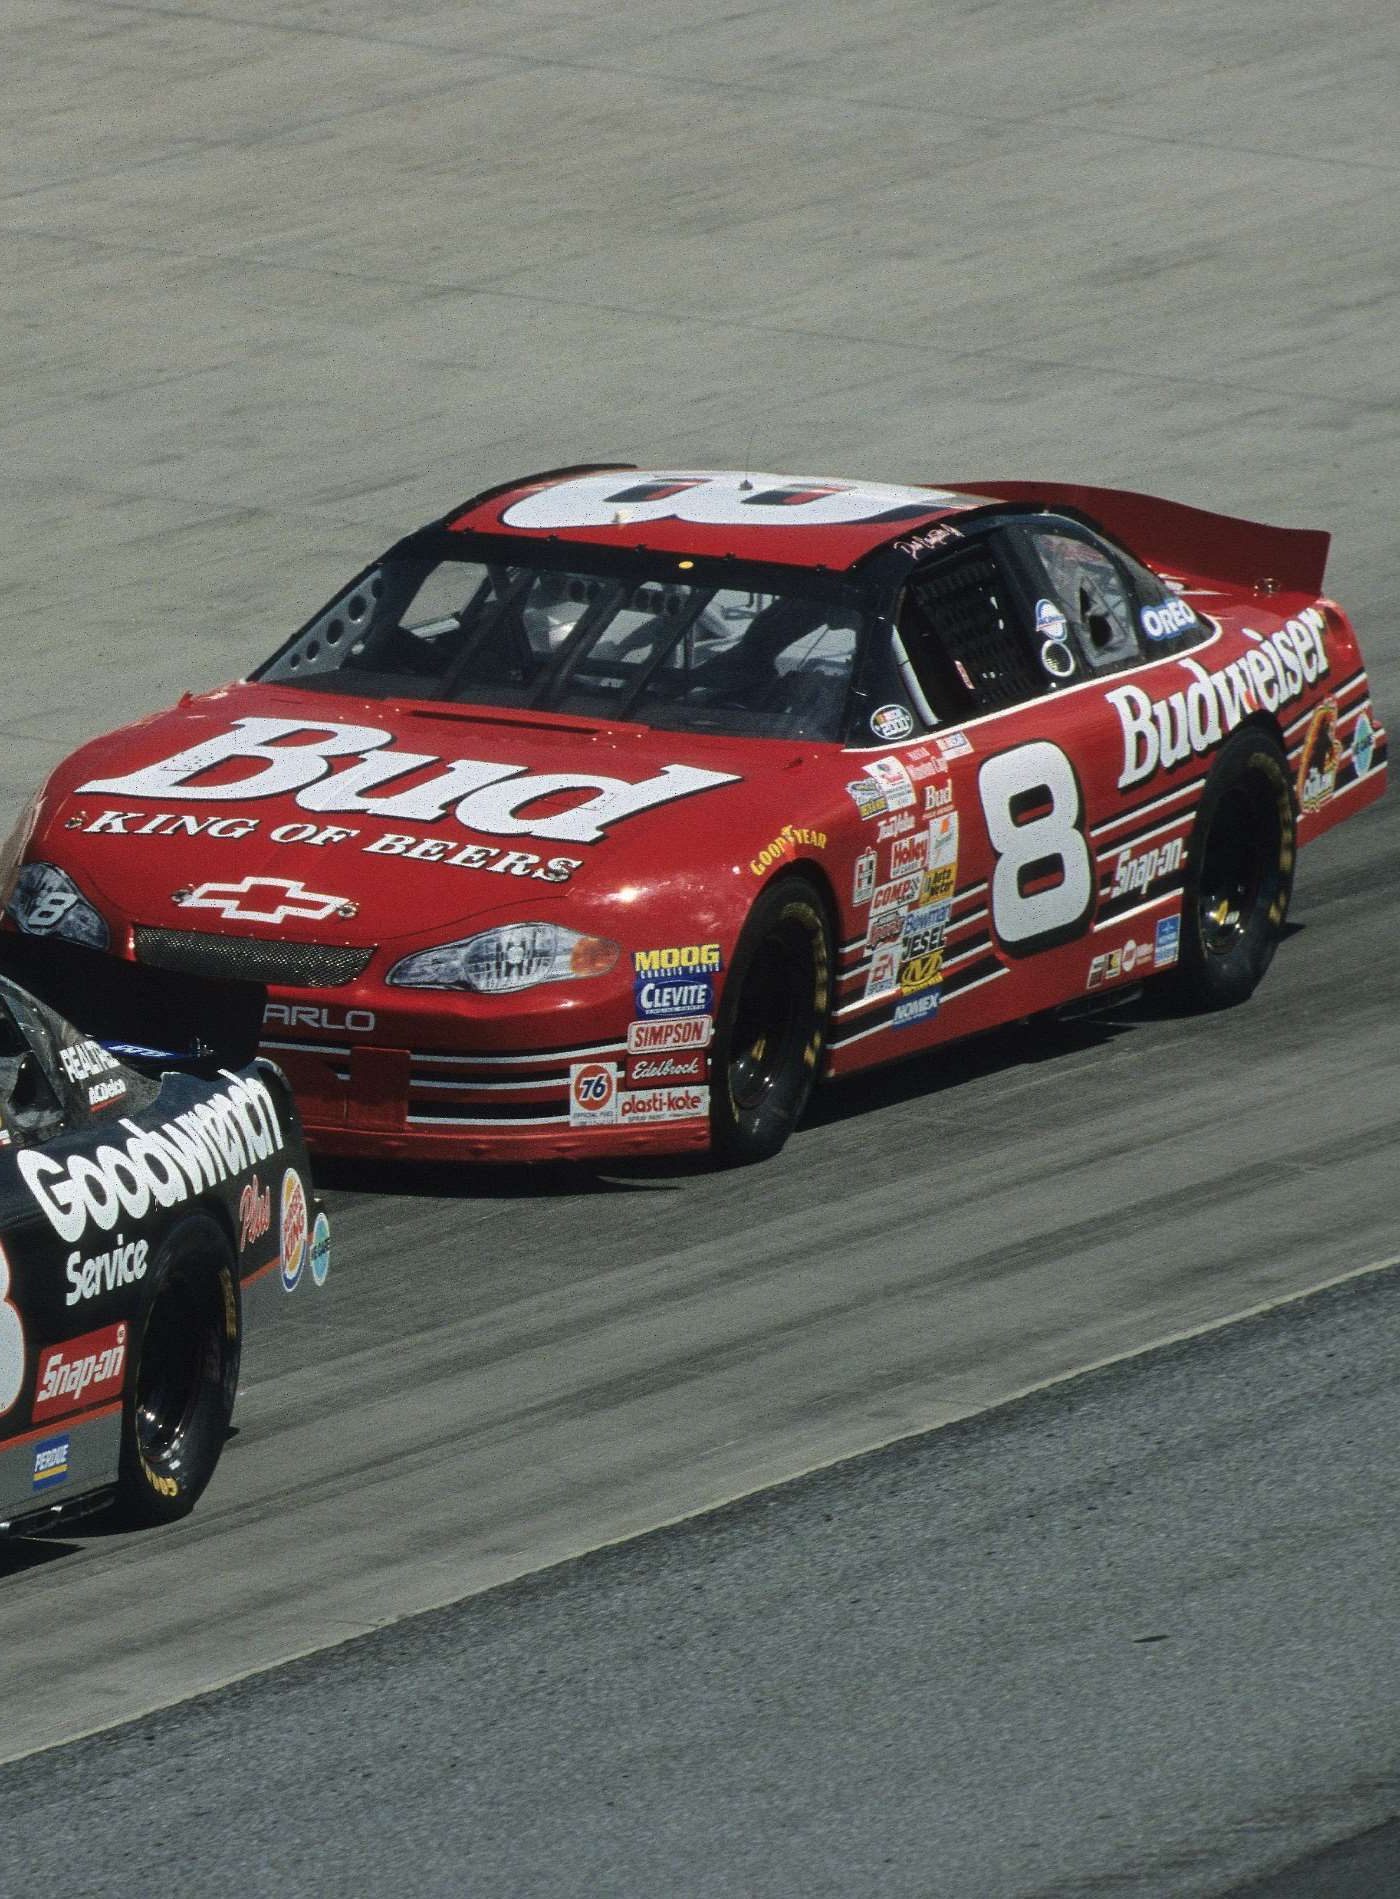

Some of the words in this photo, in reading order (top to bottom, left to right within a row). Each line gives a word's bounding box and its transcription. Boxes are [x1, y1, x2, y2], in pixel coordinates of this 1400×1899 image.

[1143, 600, 1197, 637] OREO
[1104, 607, 1329, 789] Budweiser
[74, 714, 743, 844] Bud
[924, 778, 952, 811] Bud
[82, 810, 261, 841] KING
[270, 822, 360, 848] OF
[362, 833, 586, 884] BEERS
[978, 739, 1093, 943] 8
[1111, 837, 1184, 899] Snap-on
[28, 891, 78, 927] 8
[635, 943, 720, 972] MOOG
[640, 983, 708, 1010] CLEVITE
[634, 1021, 705, 1048] SIMPSON
[631, 1057, 699, 1080] Edelbrock
[579, 1074, 608, 1101] 76
[621, 1089, 700, 1117] plasti-kote
[66, 1233, 149, 1306] Service
[36, 1344, 125, 1402] Snap-on
